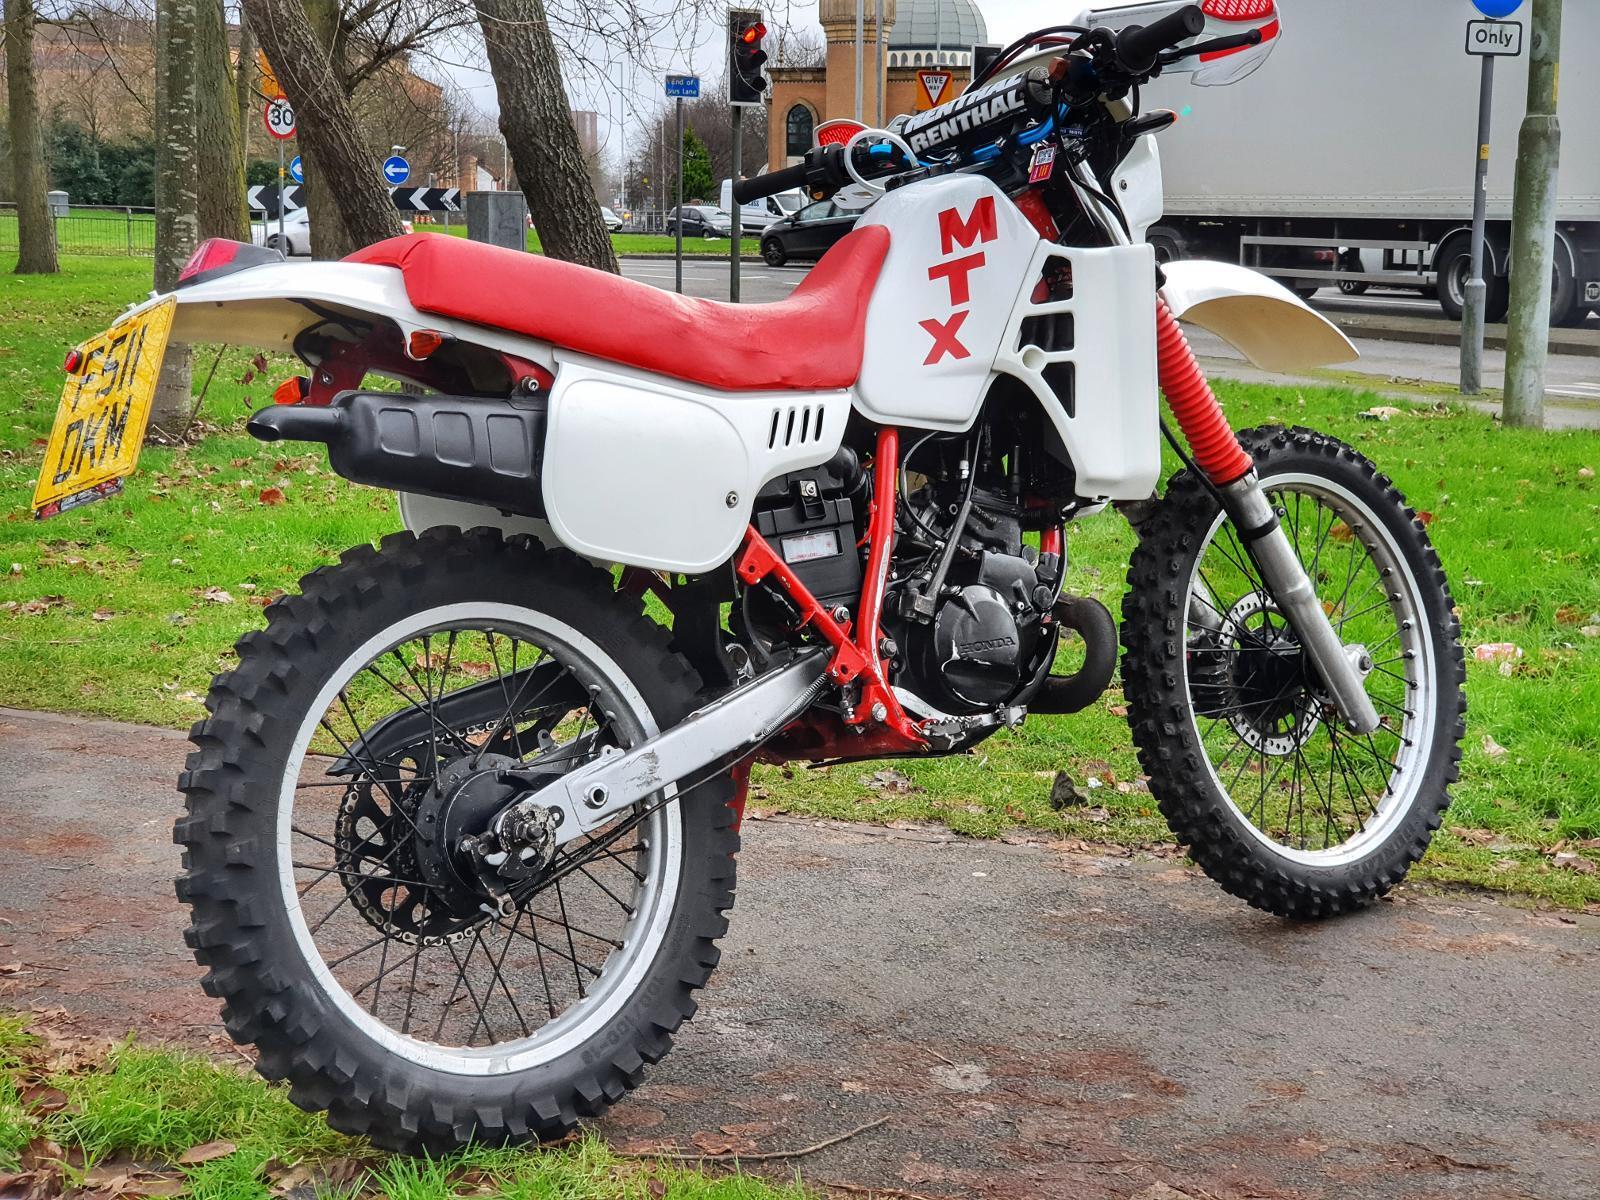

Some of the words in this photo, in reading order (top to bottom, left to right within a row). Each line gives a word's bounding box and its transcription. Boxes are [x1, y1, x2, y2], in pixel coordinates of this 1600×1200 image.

[1475, 28, 1513, 48] Only
[925, 76, 944, 84] GIVE
[270, 108, 294, 127] 30
[910, 88, 1025, 154] RENTHAL
[918, 195, 998, 366] MTX
[71, 323, 149, 413] F511
[52, 395, 132, 486] DKM
[959, 636, 1017, 656] HONDA
